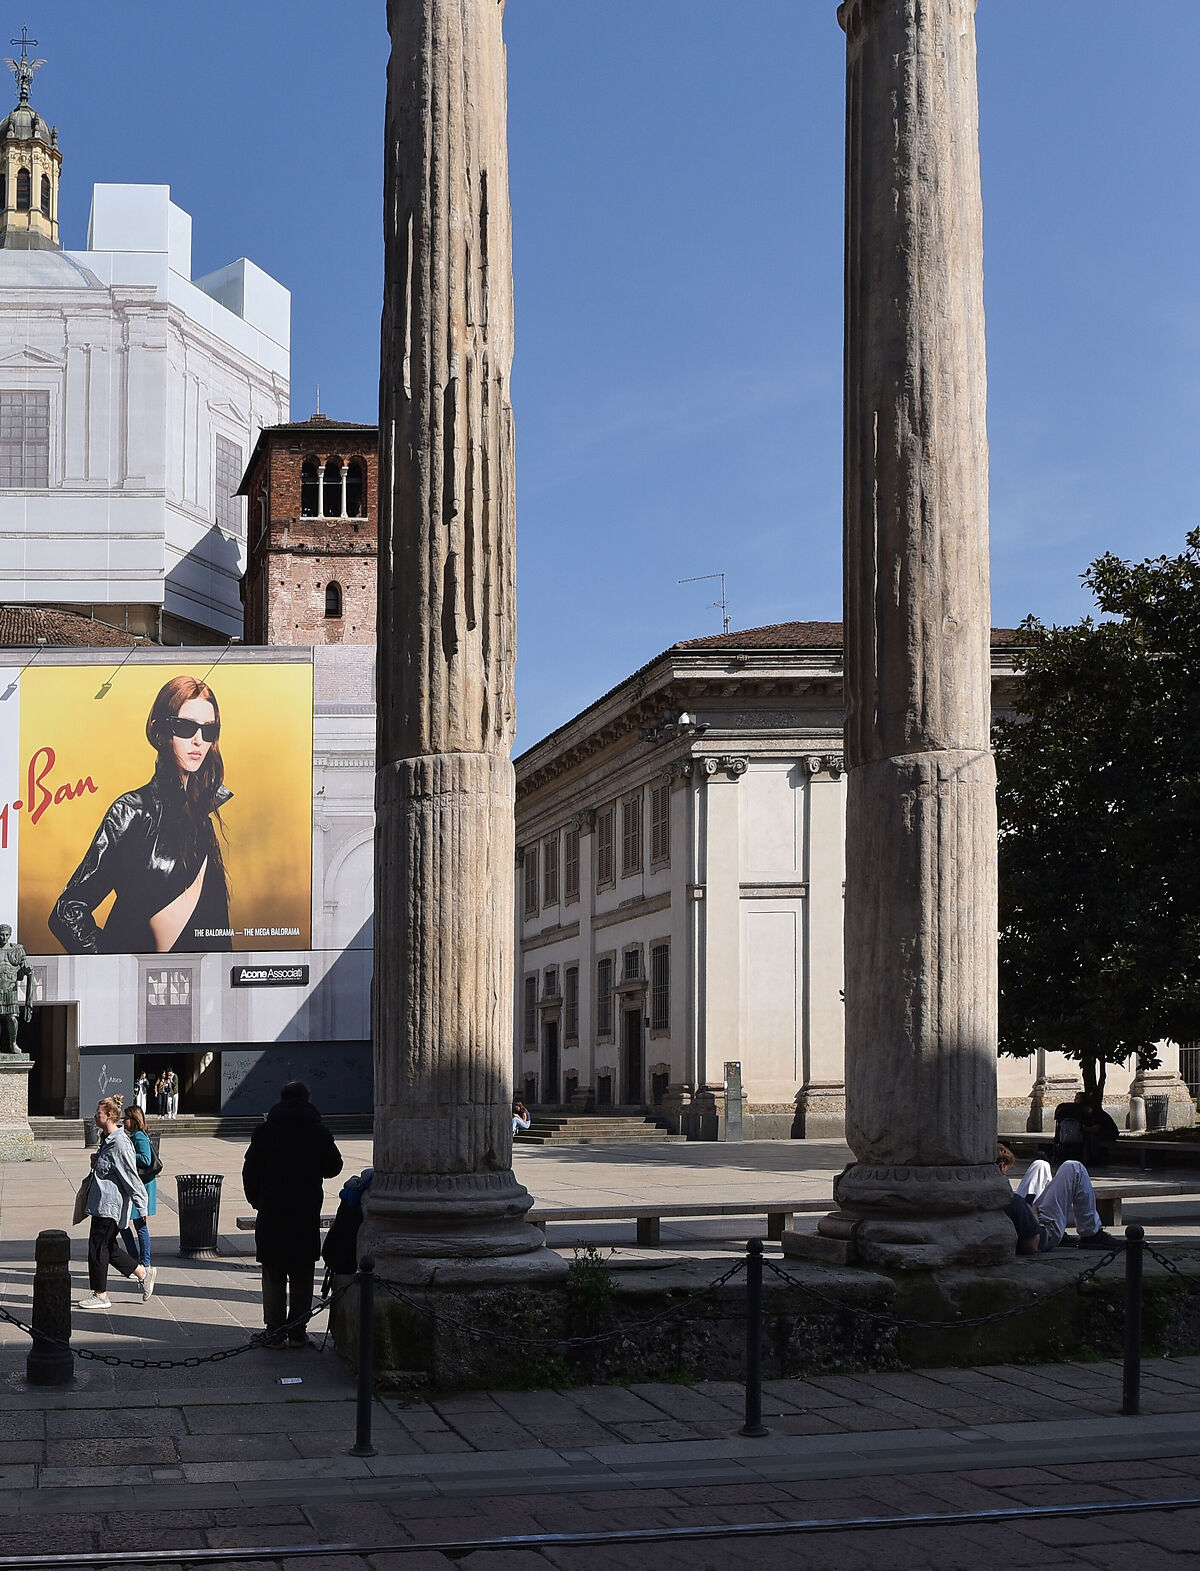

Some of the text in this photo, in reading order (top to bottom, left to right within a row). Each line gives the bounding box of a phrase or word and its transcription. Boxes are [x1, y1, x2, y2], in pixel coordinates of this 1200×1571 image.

[194, 929, 204, 937] THE
[205, 929, 235, 937] BALORAMA
[244, 928, 254, 936] THE
[255, 928, 270, 936] MEGA
[271, 927, 300, 936] BALORAMA
